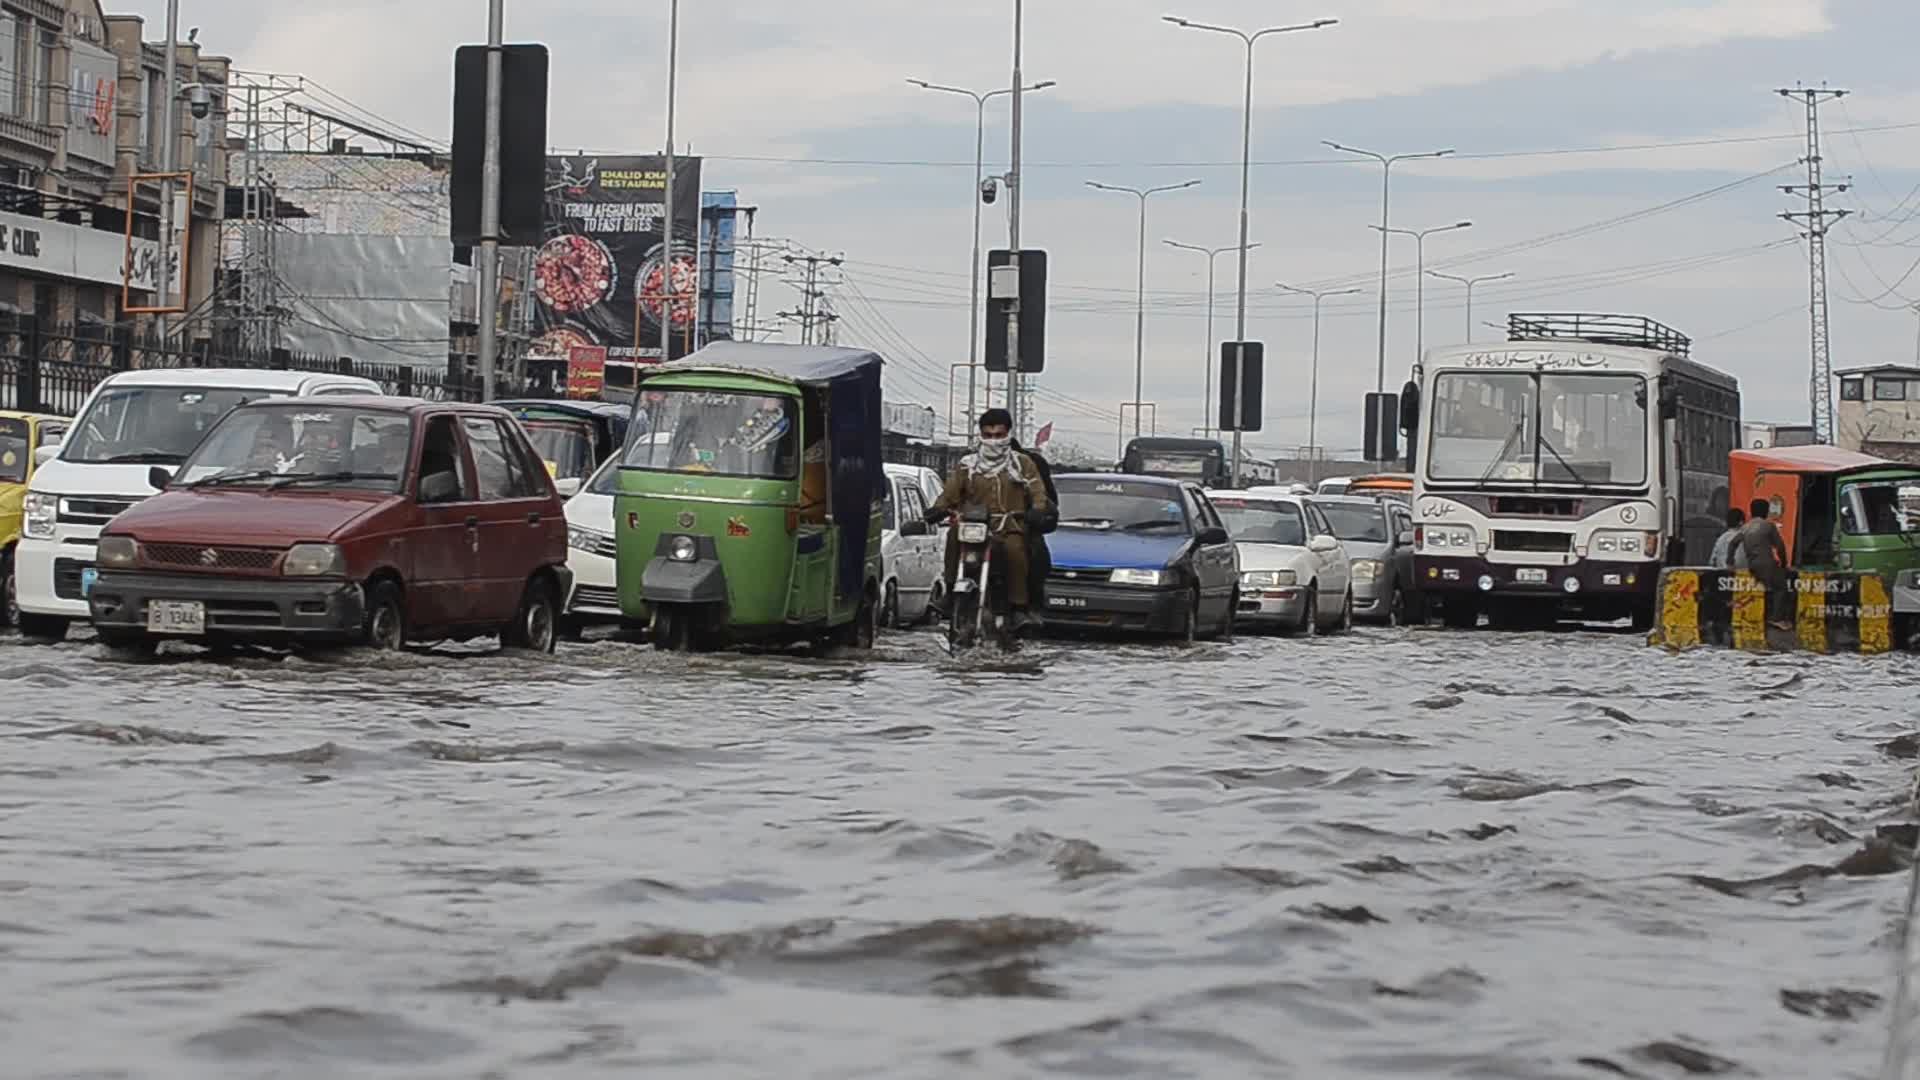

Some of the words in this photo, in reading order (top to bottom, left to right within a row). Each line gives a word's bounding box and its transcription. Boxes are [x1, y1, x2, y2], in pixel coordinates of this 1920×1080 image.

[601, 170, 641, 180] KHALID
[644, 170, 676, 180] KHA
[601, 180, 665, 189] RESTAURAN
[565, 203, 592, 217] FROM
[584, 218, 596, 232] TO
[597, 218, 621, 232] FAST
[623, 218, 653, 232] BITES
[12, 227, 41, 258] CLINIC
